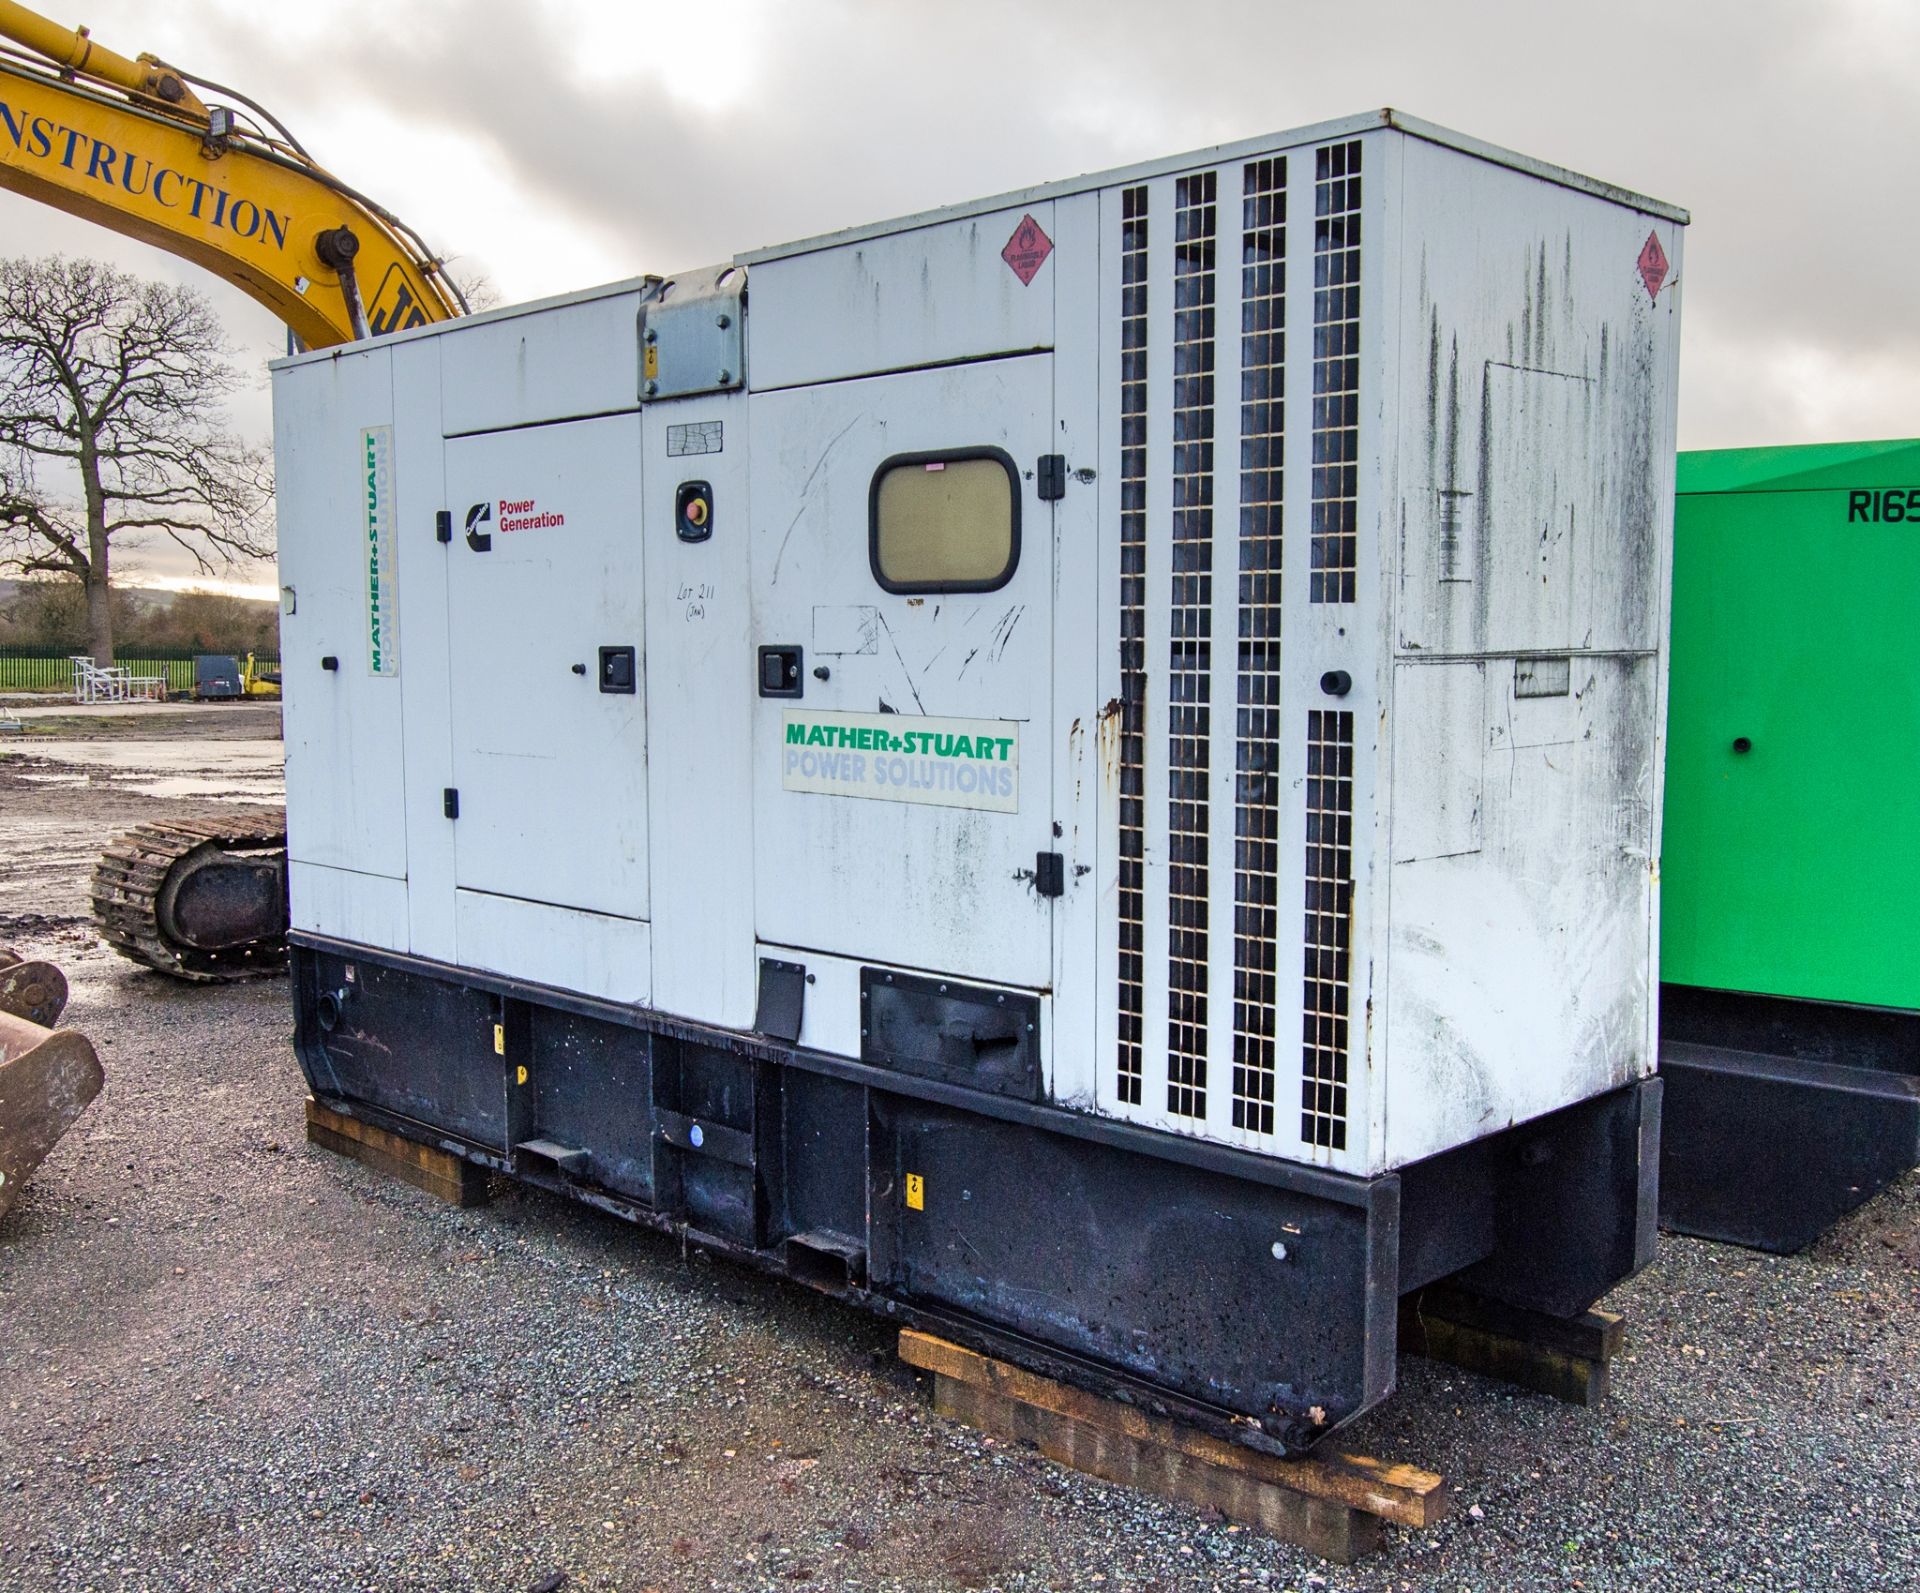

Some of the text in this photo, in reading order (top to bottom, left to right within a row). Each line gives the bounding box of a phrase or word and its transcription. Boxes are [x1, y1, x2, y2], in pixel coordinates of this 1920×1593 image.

[499, 500, 535, 516] Power
[500, 512, 564, 533] Generation
[366, 432, 381, 672] MATHER+STUART
[699, 583, 715, 599] 211
[786, 723, 1014, 761] MATHER+STUART
[786, 750, 1014, 798] POWER SOLUTIONS
